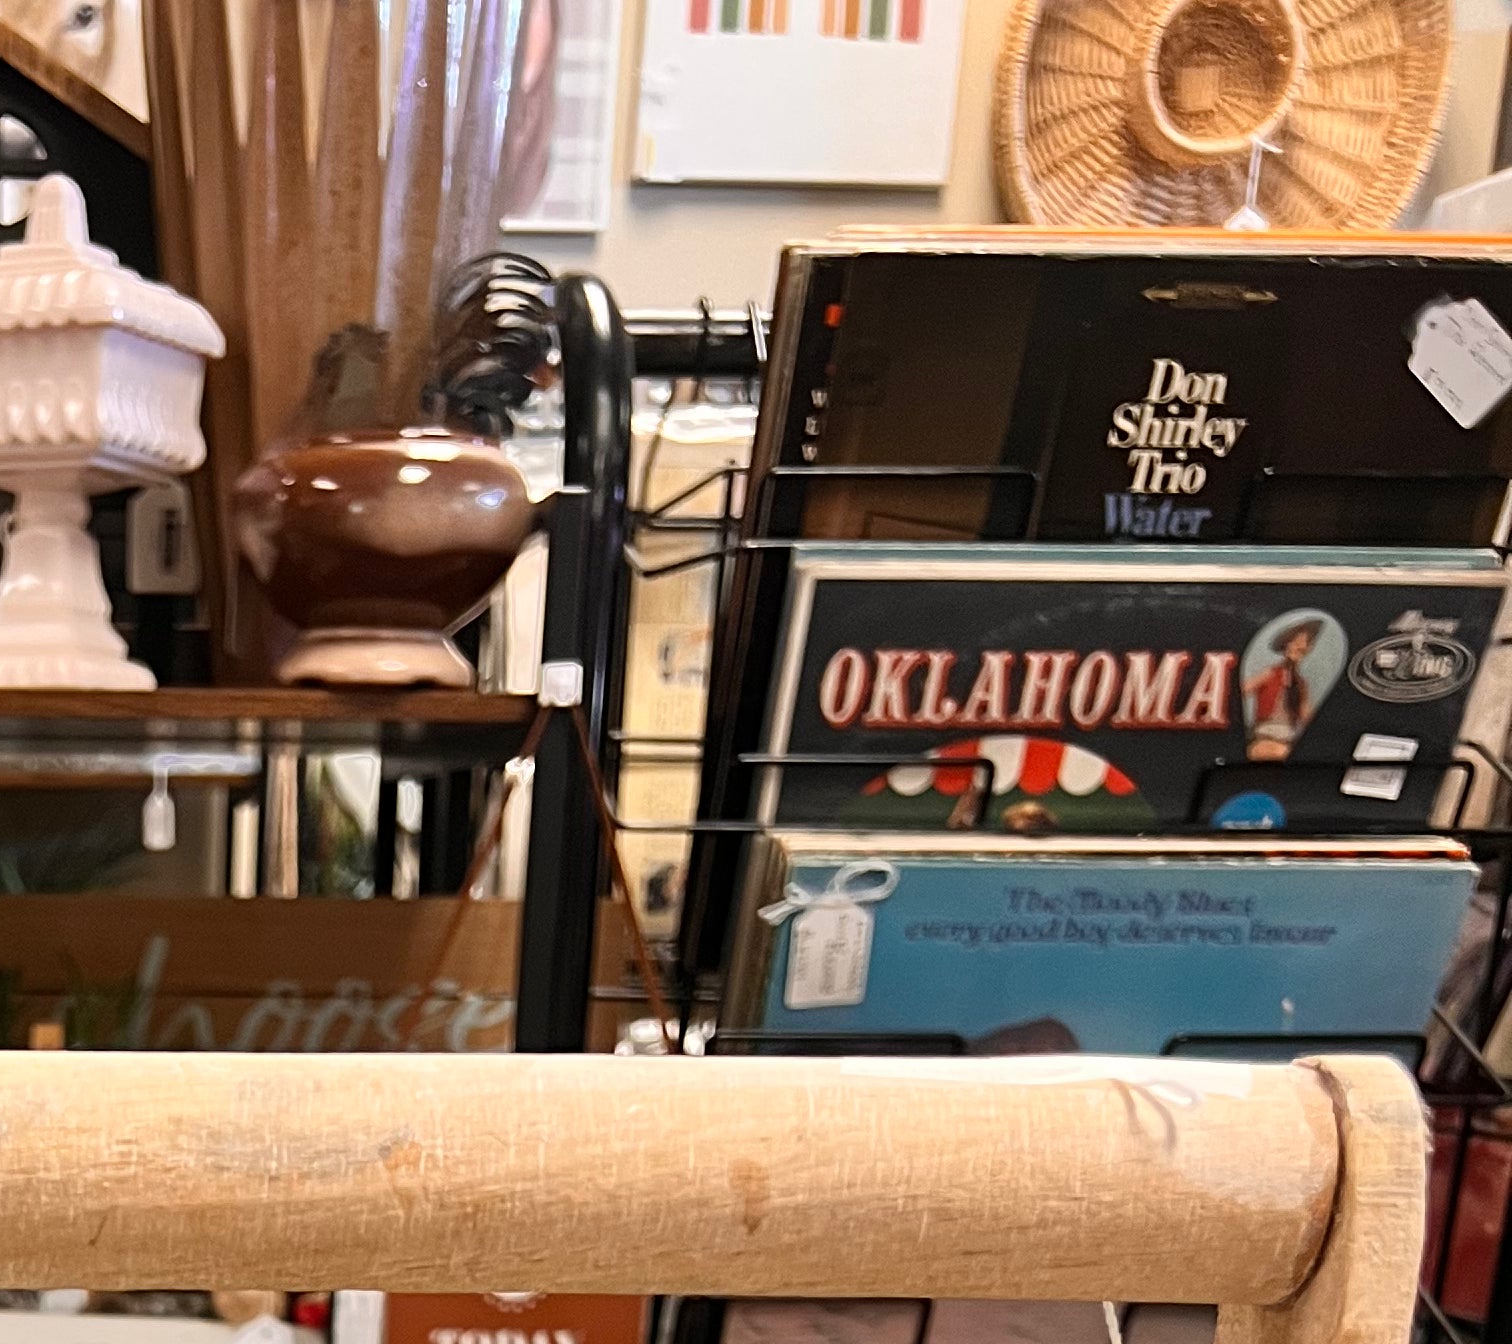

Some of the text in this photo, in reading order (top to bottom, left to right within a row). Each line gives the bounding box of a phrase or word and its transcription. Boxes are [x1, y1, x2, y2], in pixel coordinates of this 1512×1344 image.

[1147, 357, 1229, 404] Don
[1106, 402, 1250, 458] Shirley
[1127, 448, 1208, 495] Trio
[1104, 493, 1213, 537] Water
[818, 646, 1239, 732] OKLAHOMA
